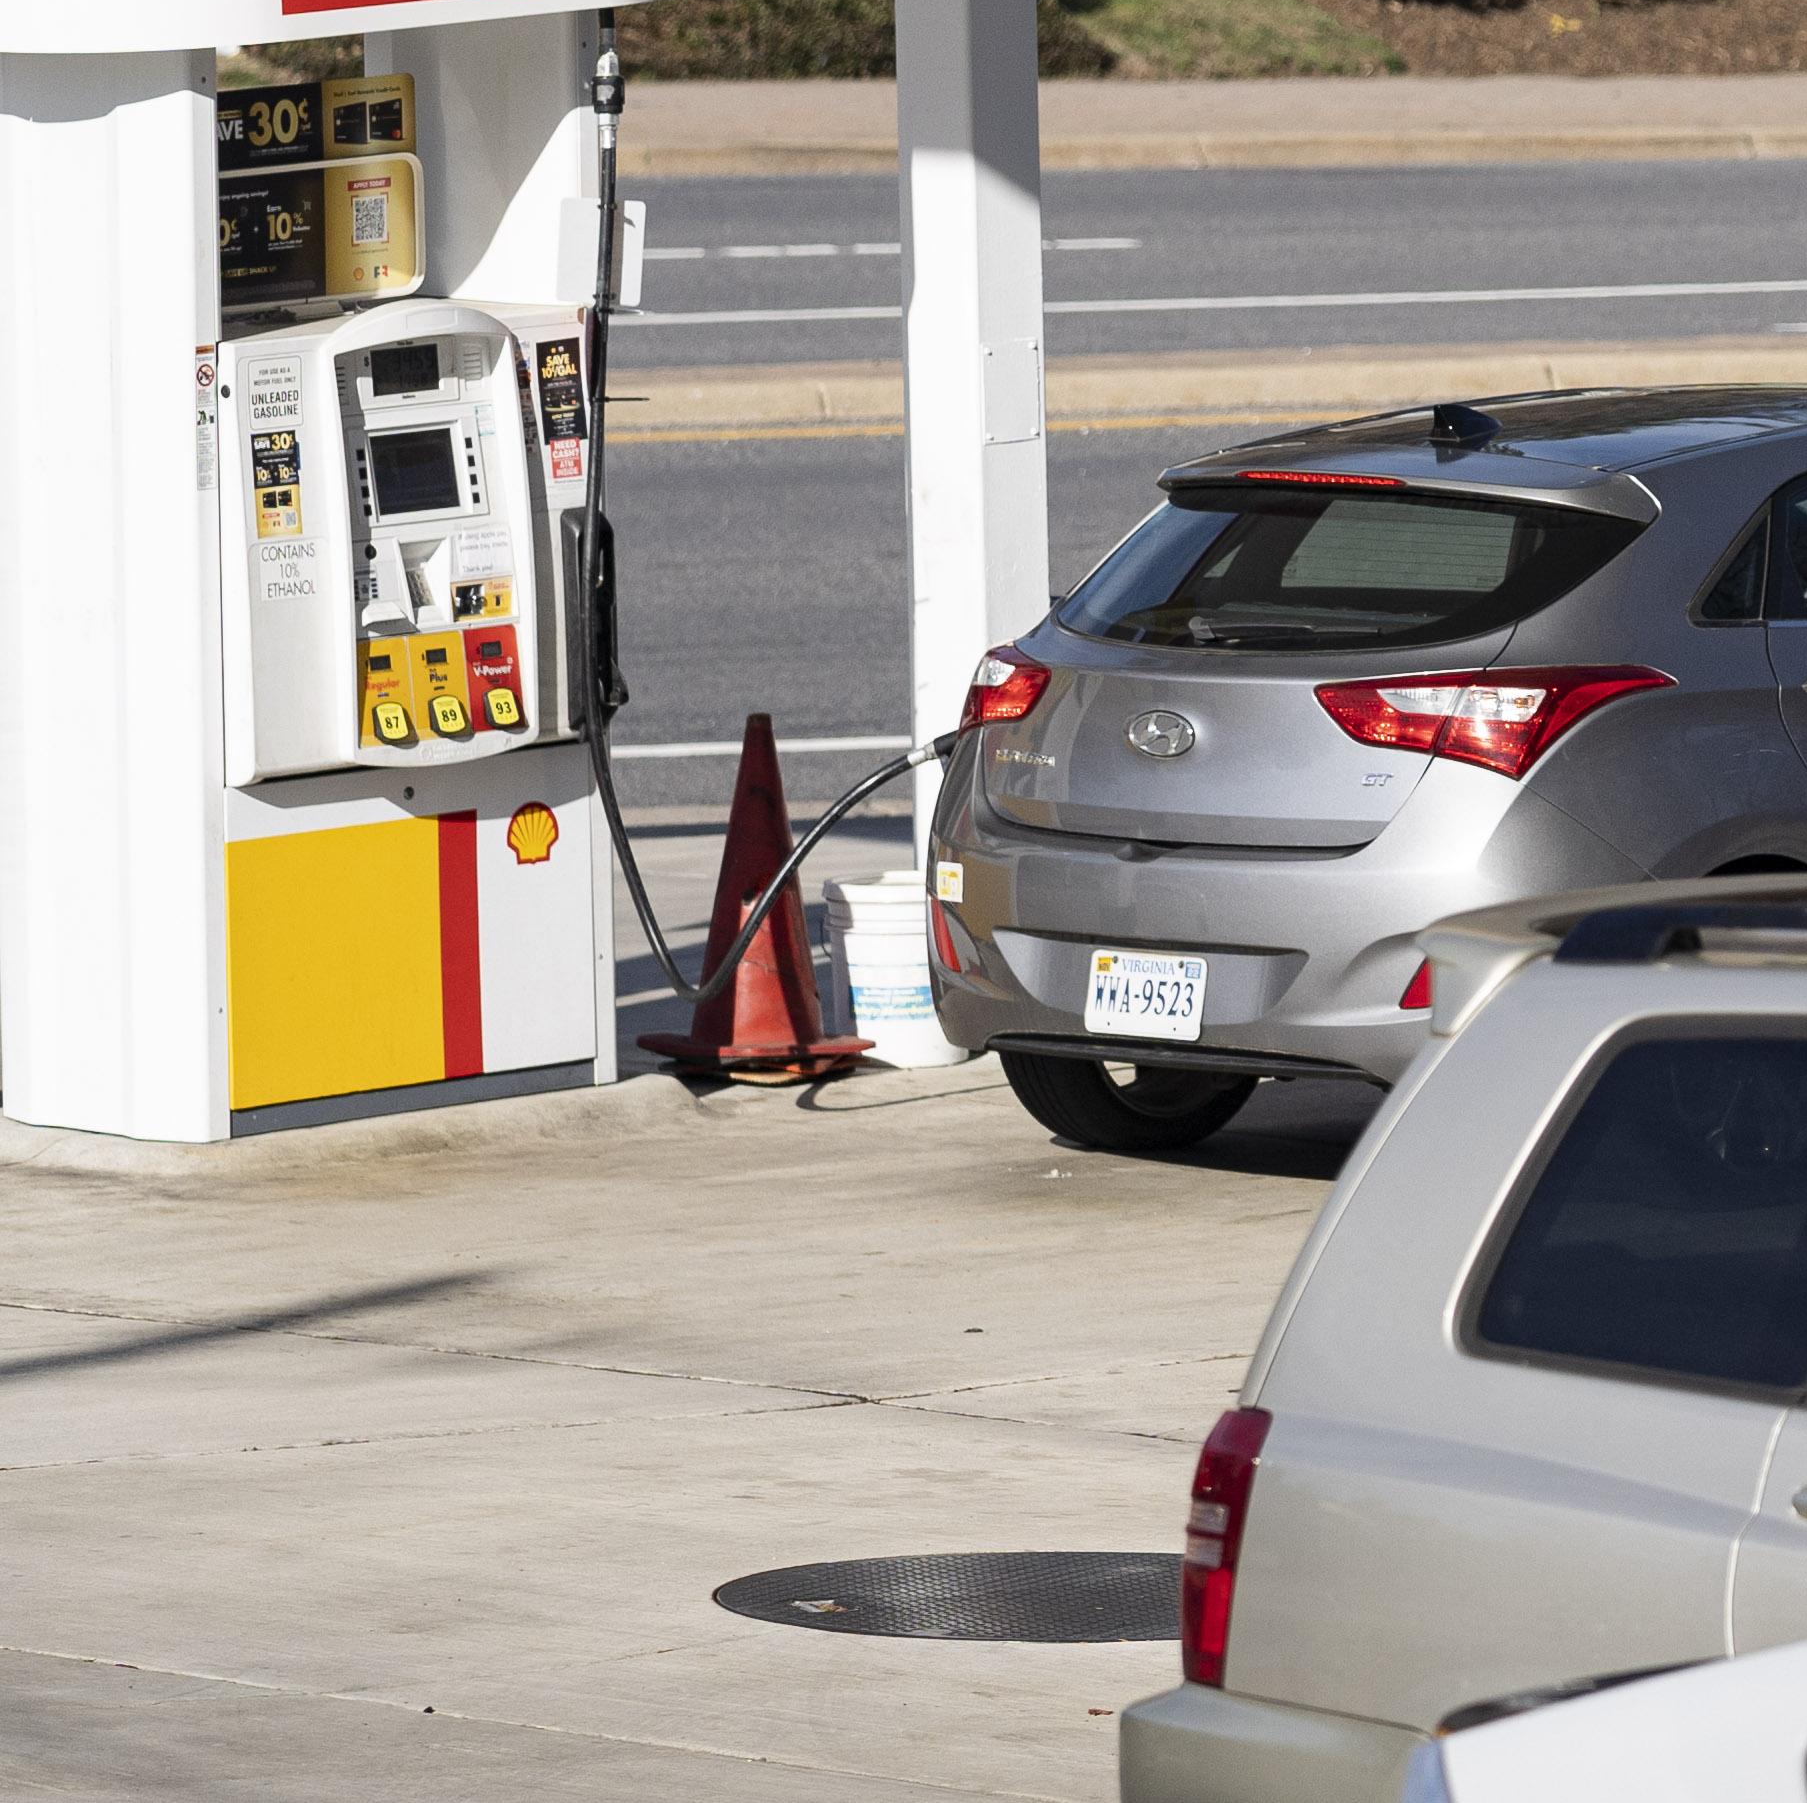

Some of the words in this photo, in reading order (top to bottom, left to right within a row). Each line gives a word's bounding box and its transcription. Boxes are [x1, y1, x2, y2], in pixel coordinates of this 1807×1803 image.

[217, 118, 243, 142] AVE
[545, 353, 571, 366] SAVE
[251, 389, 299, 406] UNLEADED
[253, 403, 299, 419] GASOLINE
[553, 439, 577, 450] NEED
[552, 448, 579, 460] CASH?
[559, 460, 574, 469] ATM
[556, 467, 579, 478] INSIDE
[261, 542, 316, 563] CONTAINS
[279, 562, 300, 579] 10%
[267, 579, 316, 598] ETHANOL
[473, 664, 513, 677] V-Power
[366, 678, 400, 692] Regular
[429, 672, 448, 684] Plus
[495, 701, 513, 715] 93
[384, 715, 400, 729] 87
[441, 708, 458, 723] 89
[1361, 772, 1395, 788] GT
[1122, 958, 1175, 975] VIRGINIA
[1095, 973, 1195, 1018] WWA-9523
